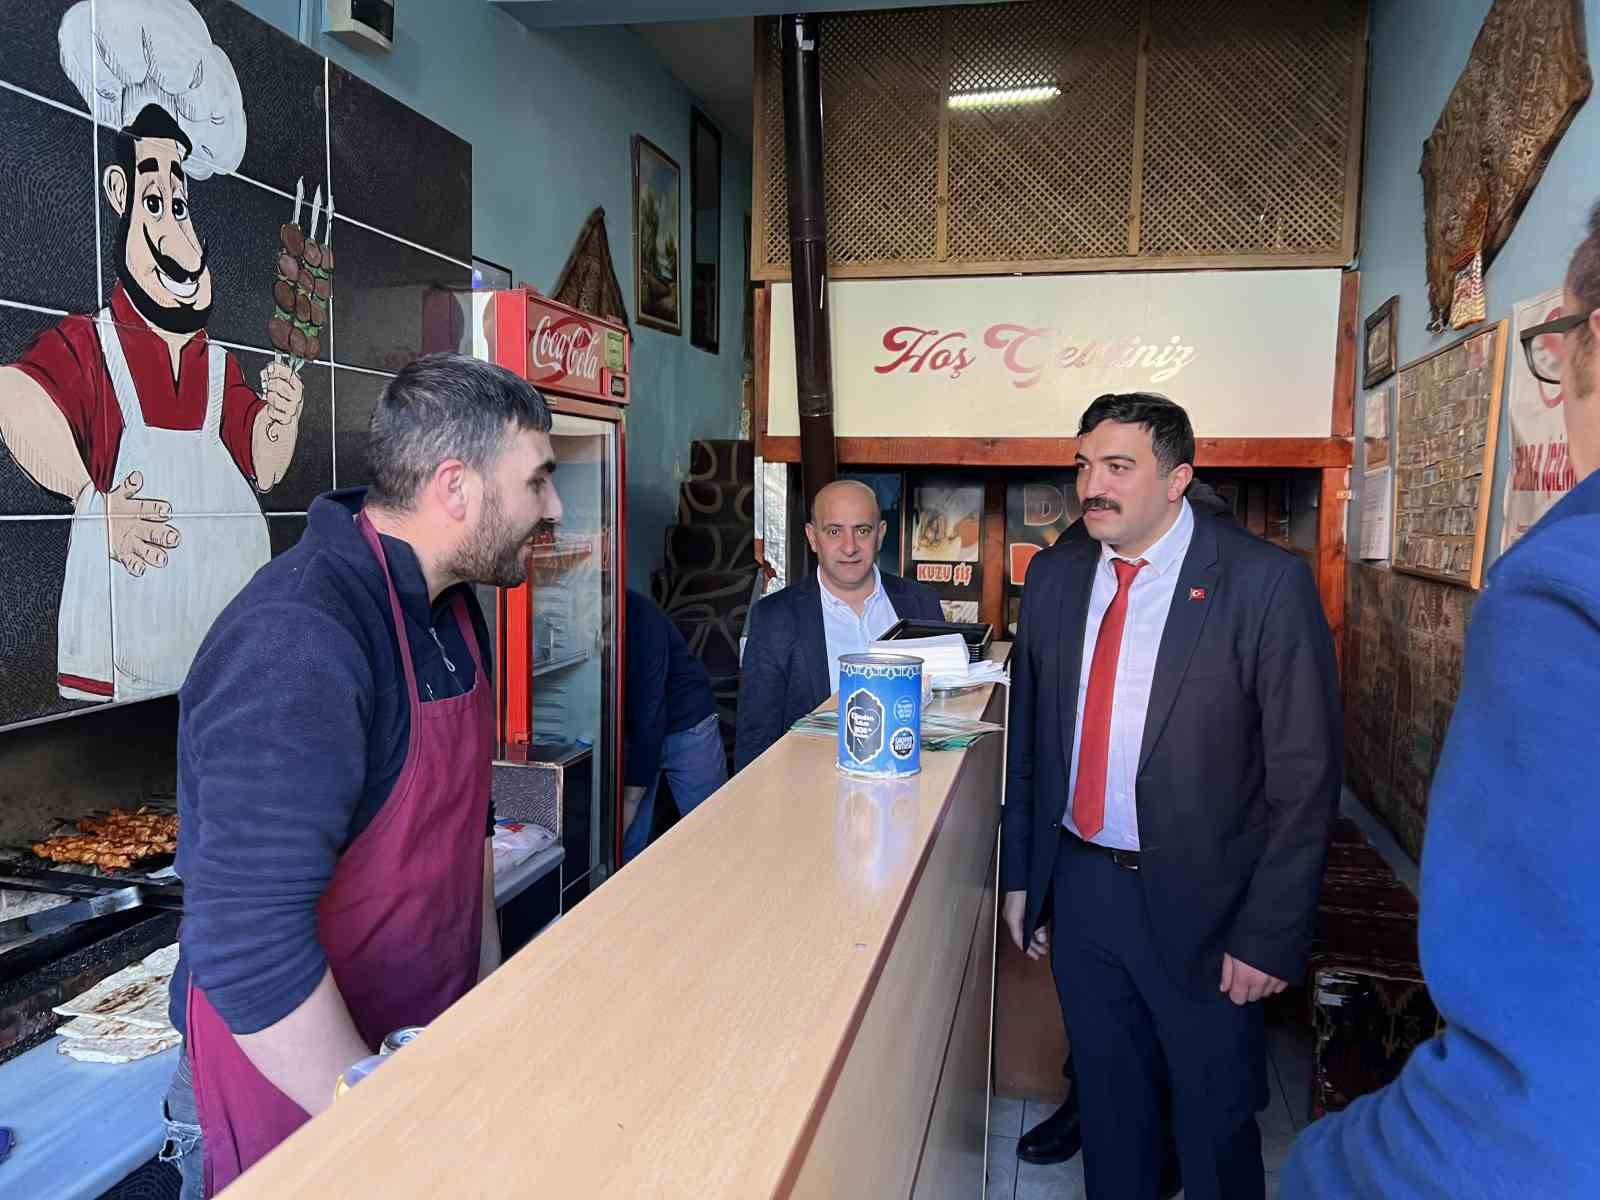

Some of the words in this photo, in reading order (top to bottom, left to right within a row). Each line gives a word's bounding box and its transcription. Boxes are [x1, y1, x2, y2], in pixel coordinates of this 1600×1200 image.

[873, 325, 976, 379] Hoş
[983, 323, 1198, 389] Geiniz
[917, 564, 952, 582] KUZU
[953, 562, 973, 586] ŞİŞ
